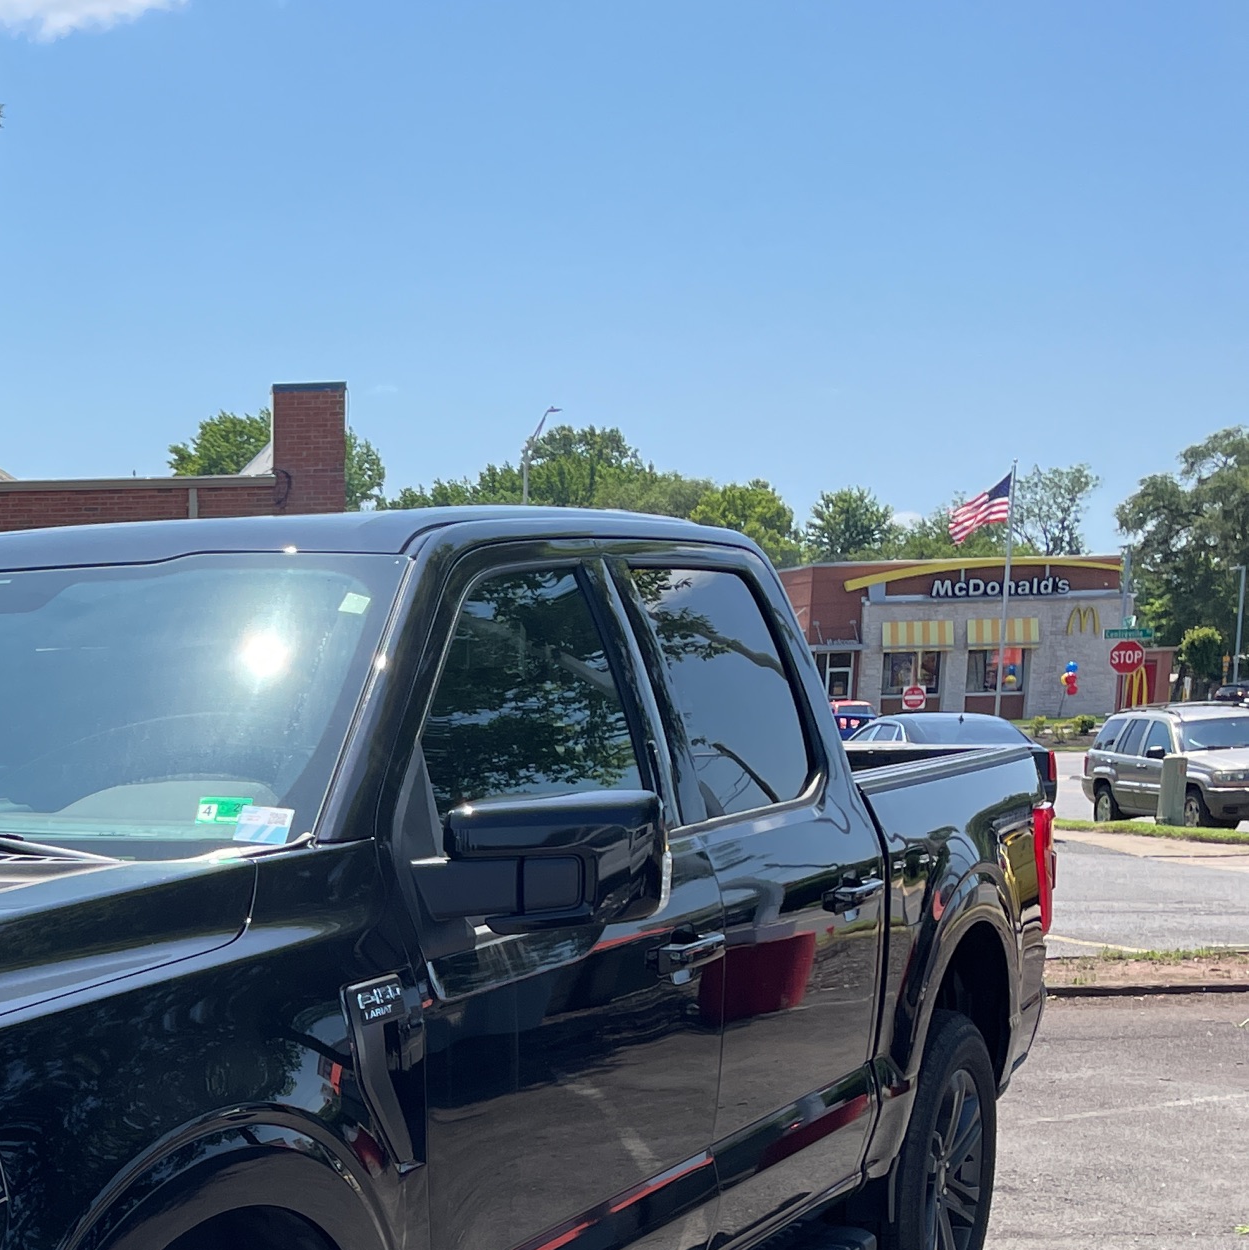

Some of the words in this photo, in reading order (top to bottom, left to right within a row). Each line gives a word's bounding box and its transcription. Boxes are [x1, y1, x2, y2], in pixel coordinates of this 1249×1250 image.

[1111, 650, 1142, 664] STOP
[202, 804, 212, 817] 4
[364, 1004, 392, 1021] LARIAT
